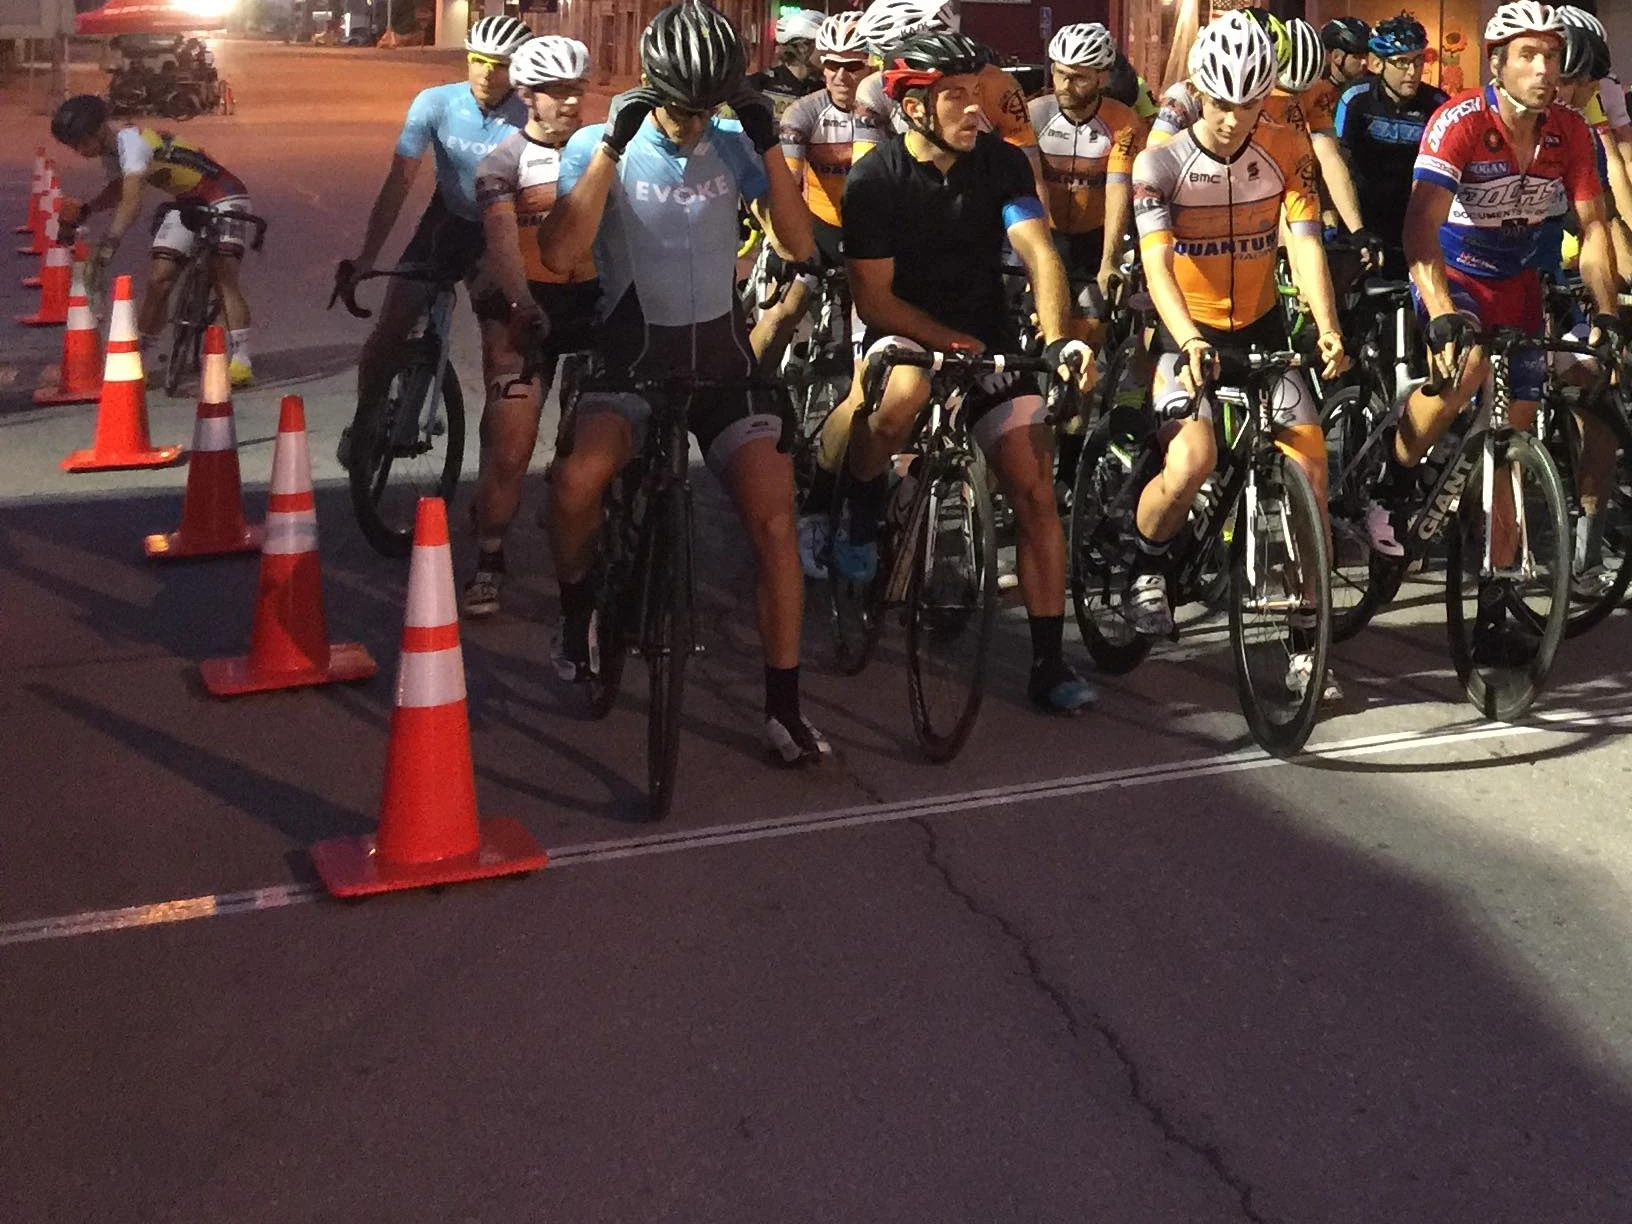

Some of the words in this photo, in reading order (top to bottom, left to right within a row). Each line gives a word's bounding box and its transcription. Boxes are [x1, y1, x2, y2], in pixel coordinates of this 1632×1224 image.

[635, 176, 729, 206] EVOKE
[1189, 172, 1222, 184] BMC
[1418, 453, 1473, 540] GIANT
